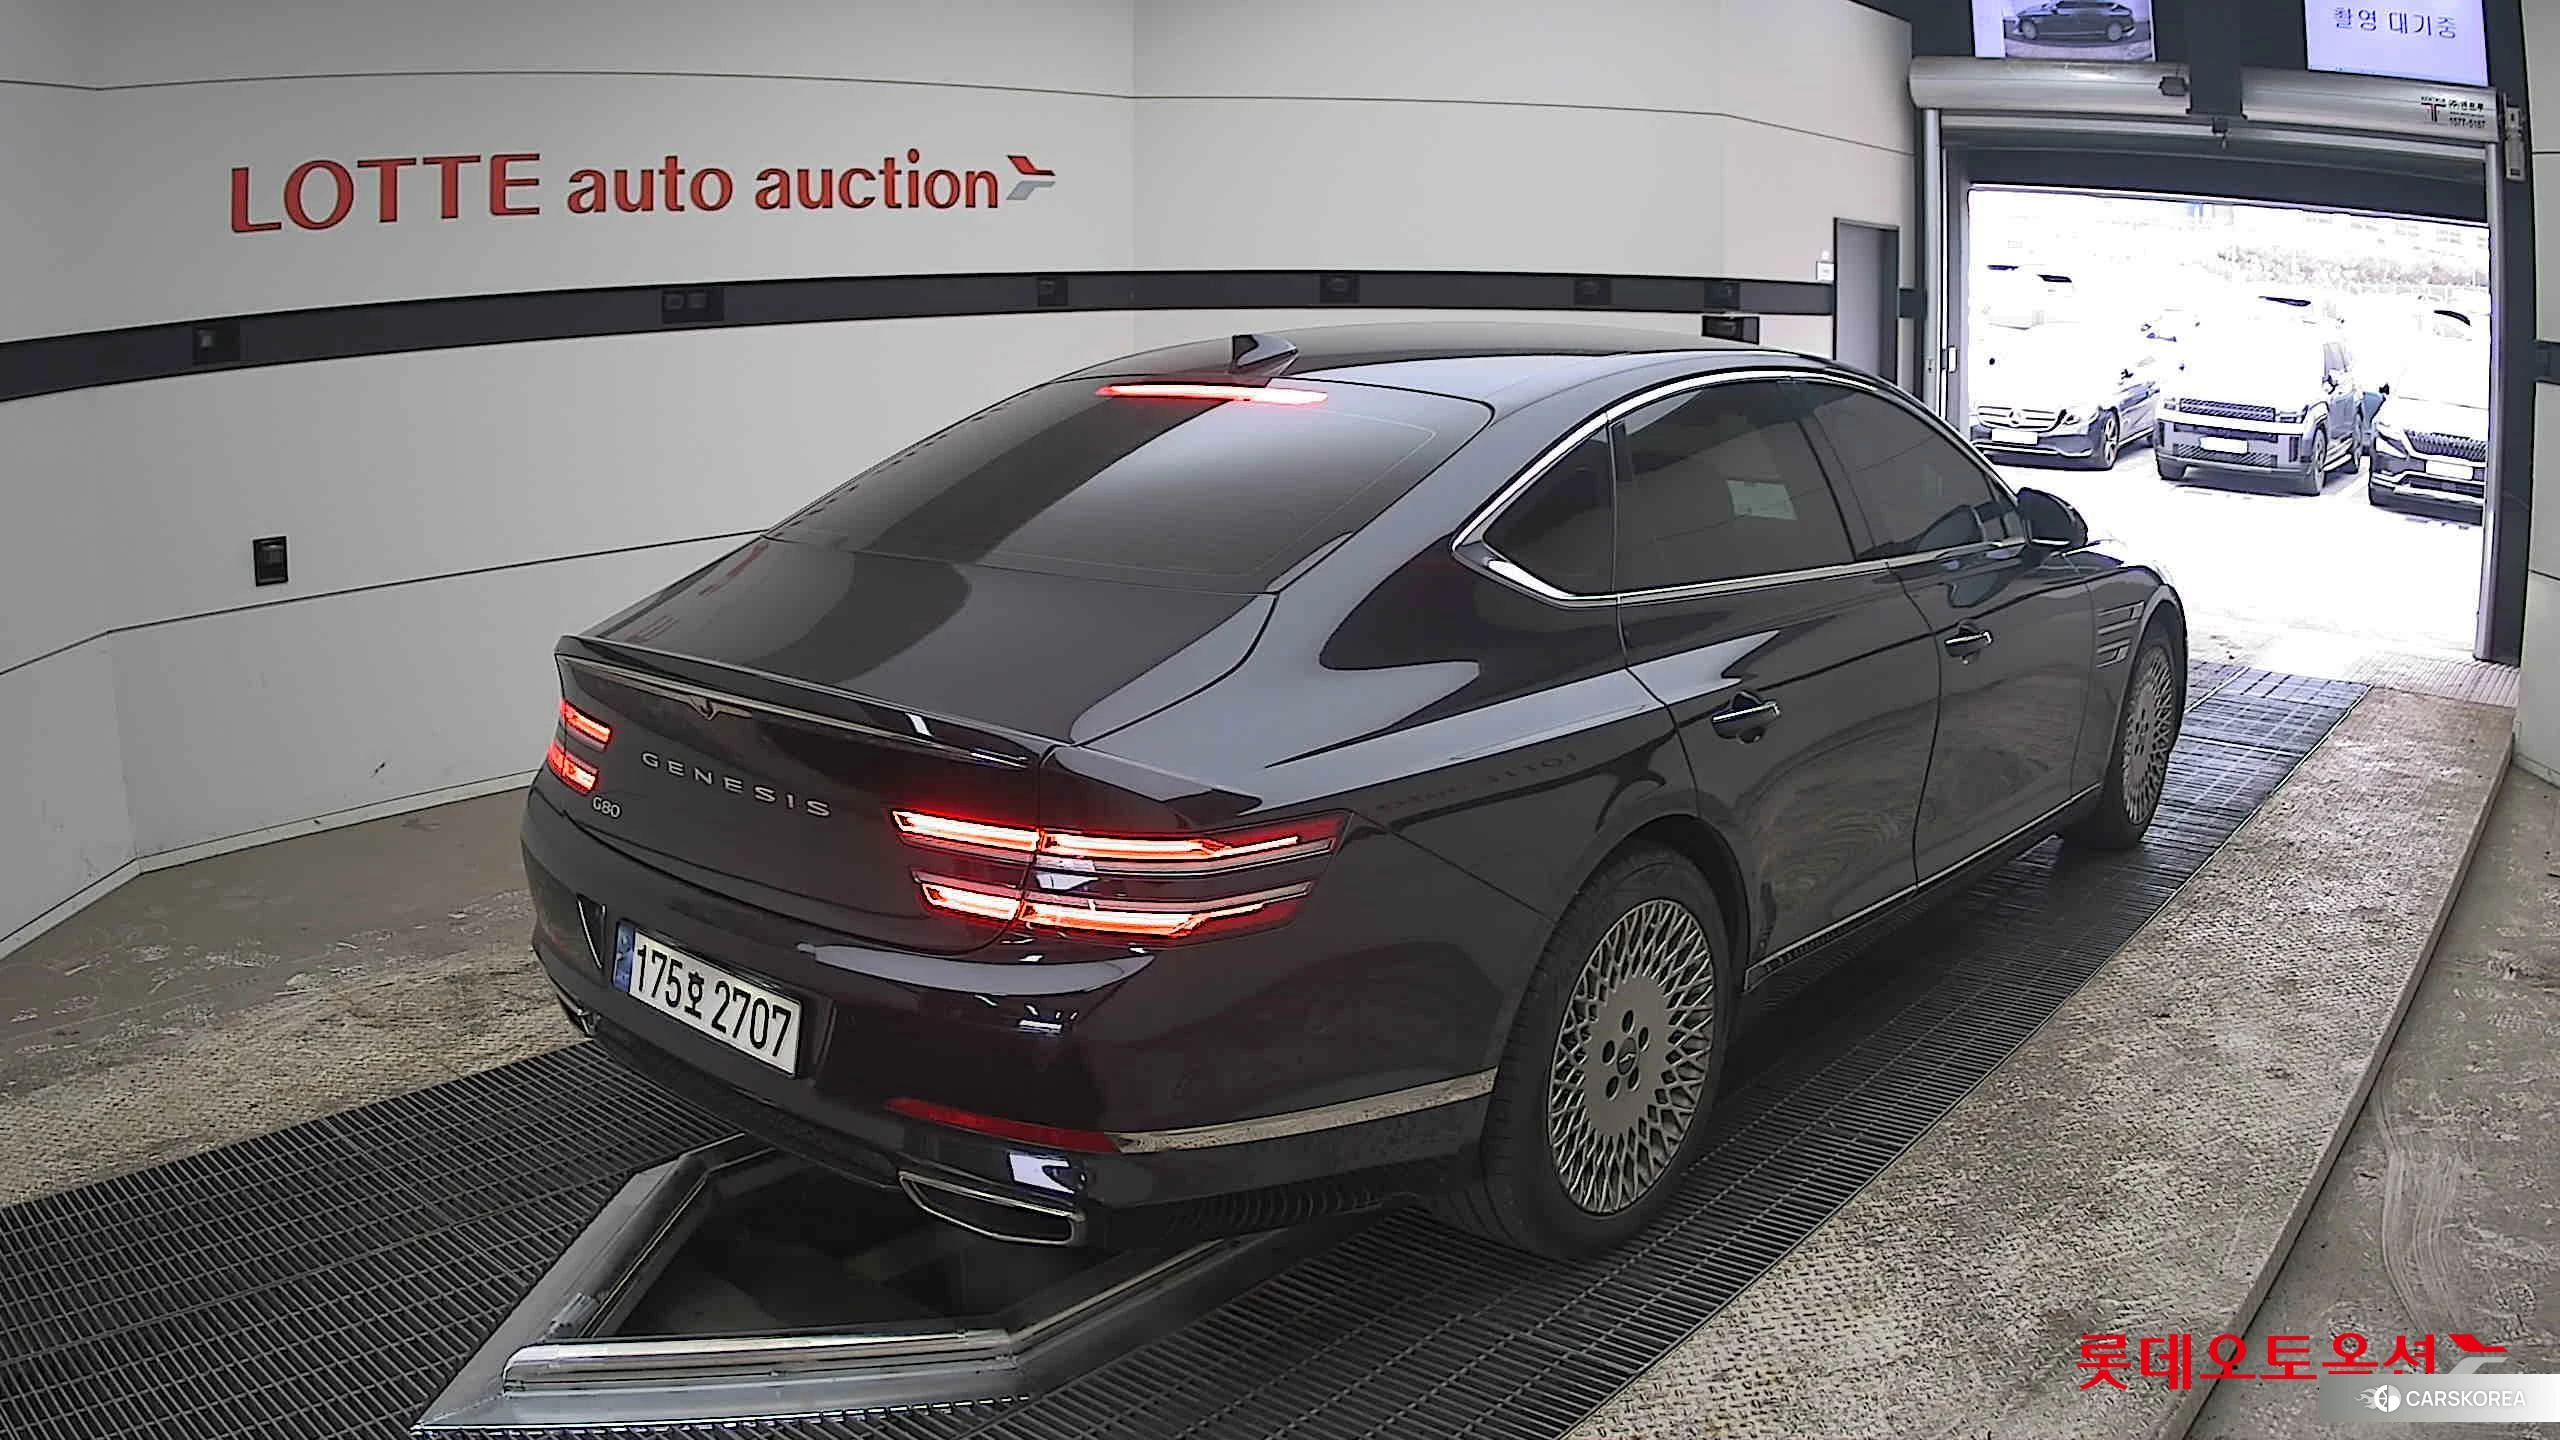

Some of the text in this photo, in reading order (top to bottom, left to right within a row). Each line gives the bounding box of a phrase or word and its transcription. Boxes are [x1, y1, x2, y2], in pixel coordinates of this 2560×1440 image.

[2335, 7, 2457, 39] 촬영 대기중
[230, 148, 1000, 234] LOTTE auto auction
[592, 797, 621, 818] G80
[641, 752, 831, 817] GENESIS
[637, 945, 792, 1057] 175호 2707
